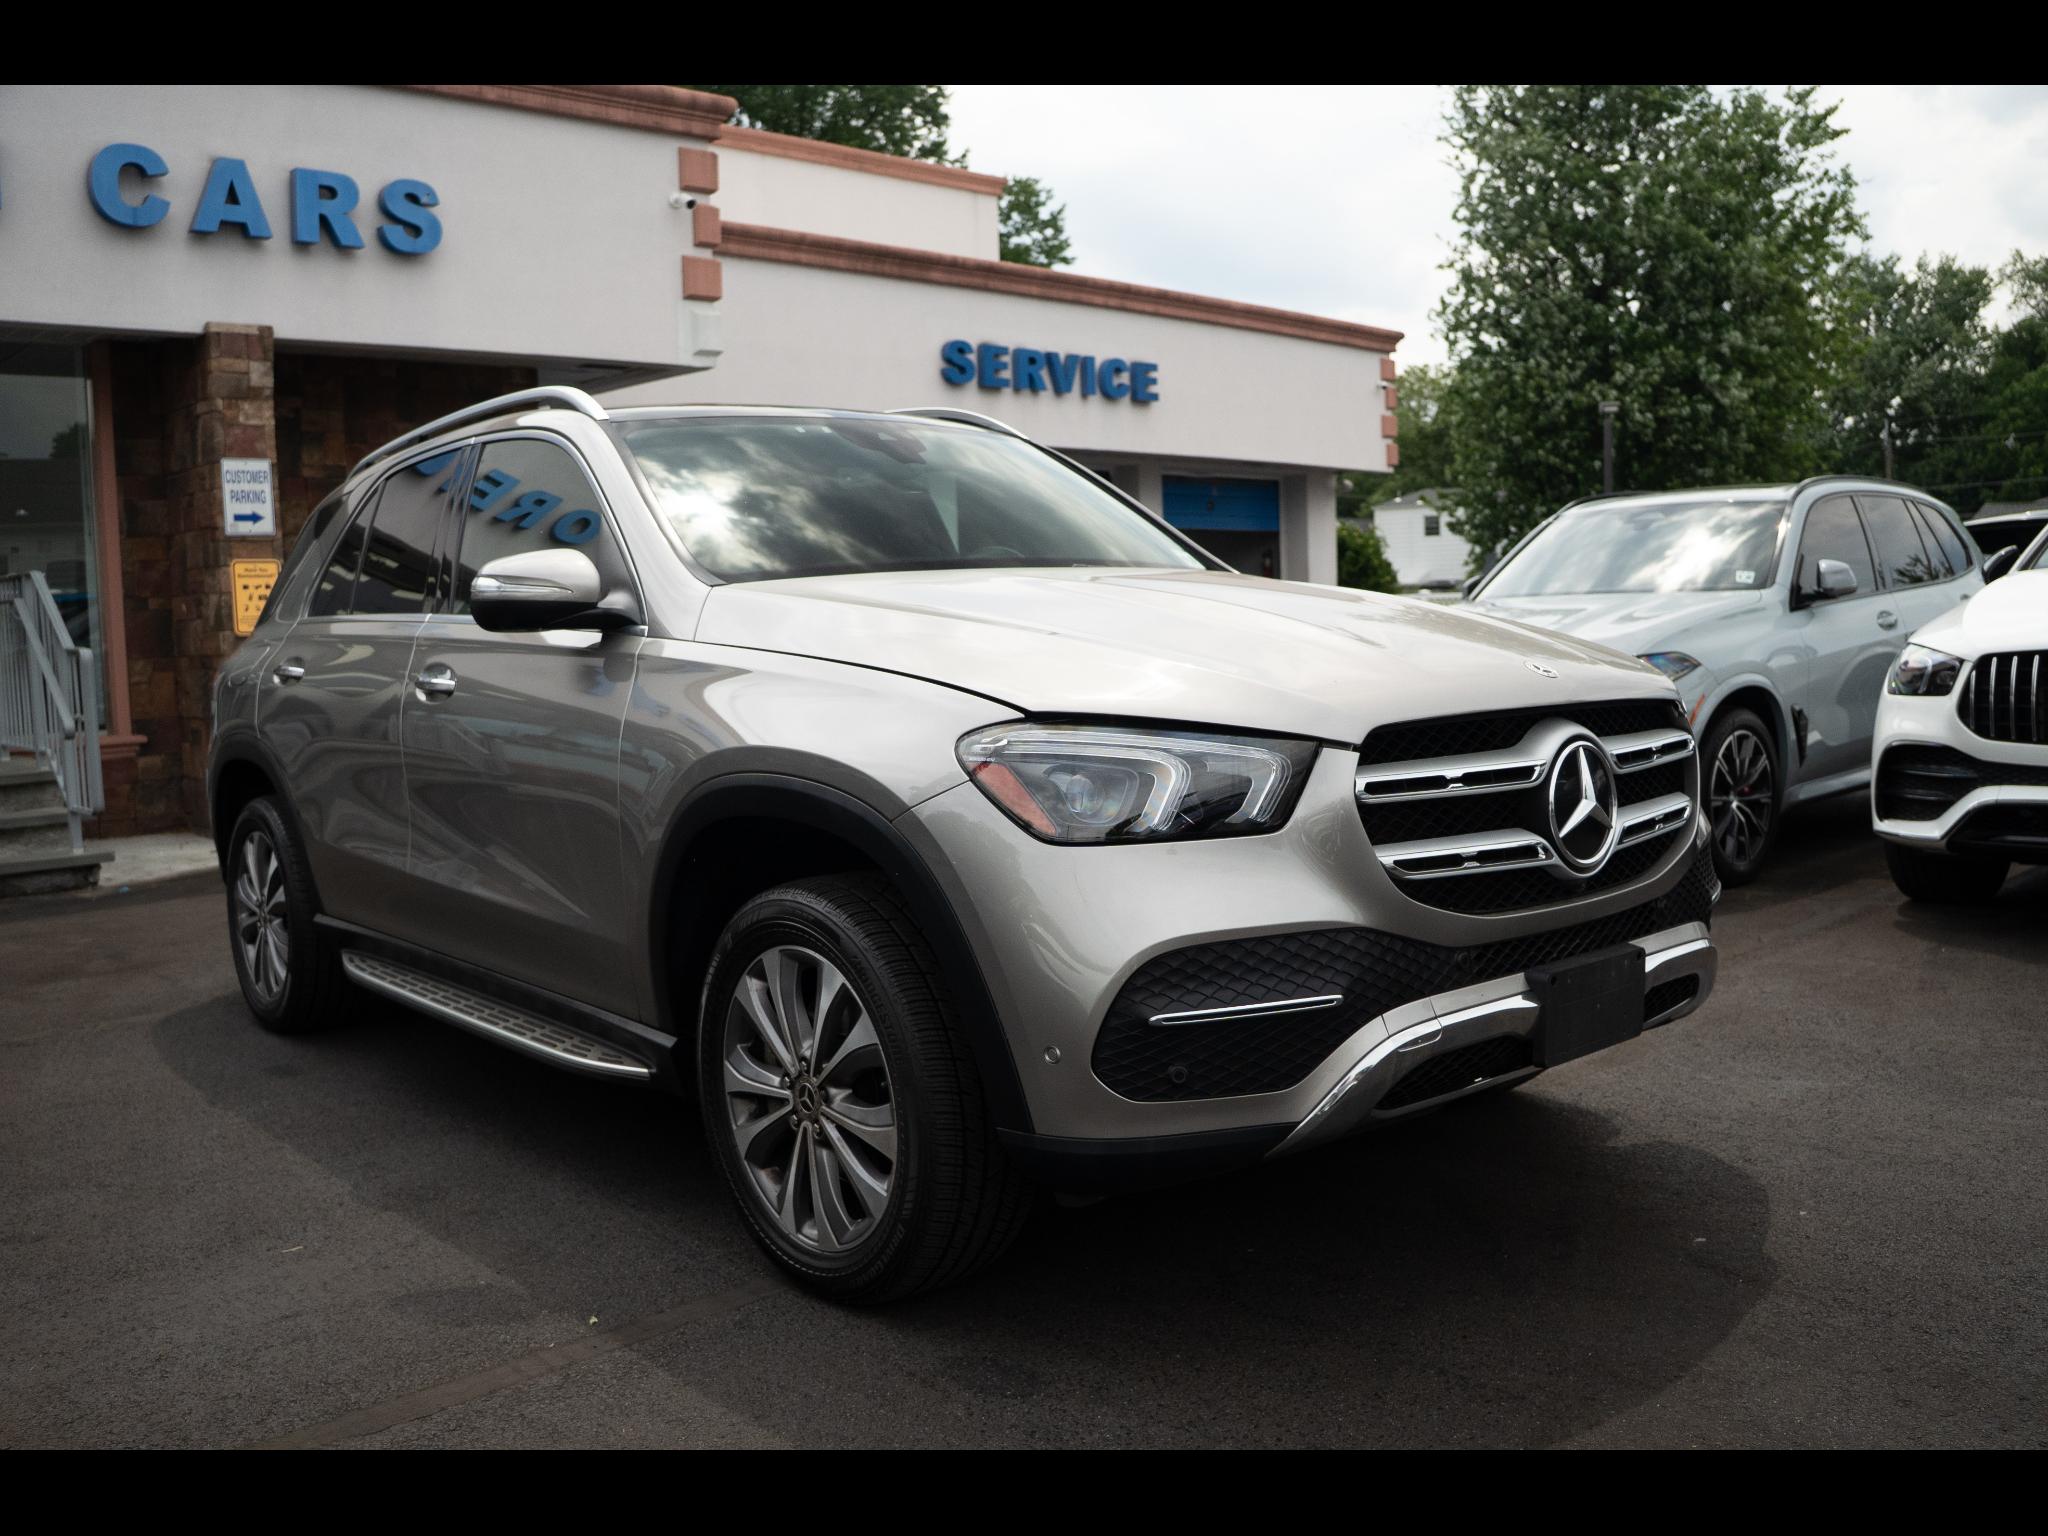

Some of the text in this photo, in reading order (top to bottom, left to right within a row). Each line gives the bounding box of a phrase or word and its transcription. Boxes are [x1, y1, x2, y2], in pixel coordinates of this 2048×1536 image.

[88, 143, 443, 256] CARS
[940, 339, 1160, 402] SERVICE
[225, 469, 269, 484] CUSTOMER
[230, 490, 267, 504] PARKING
